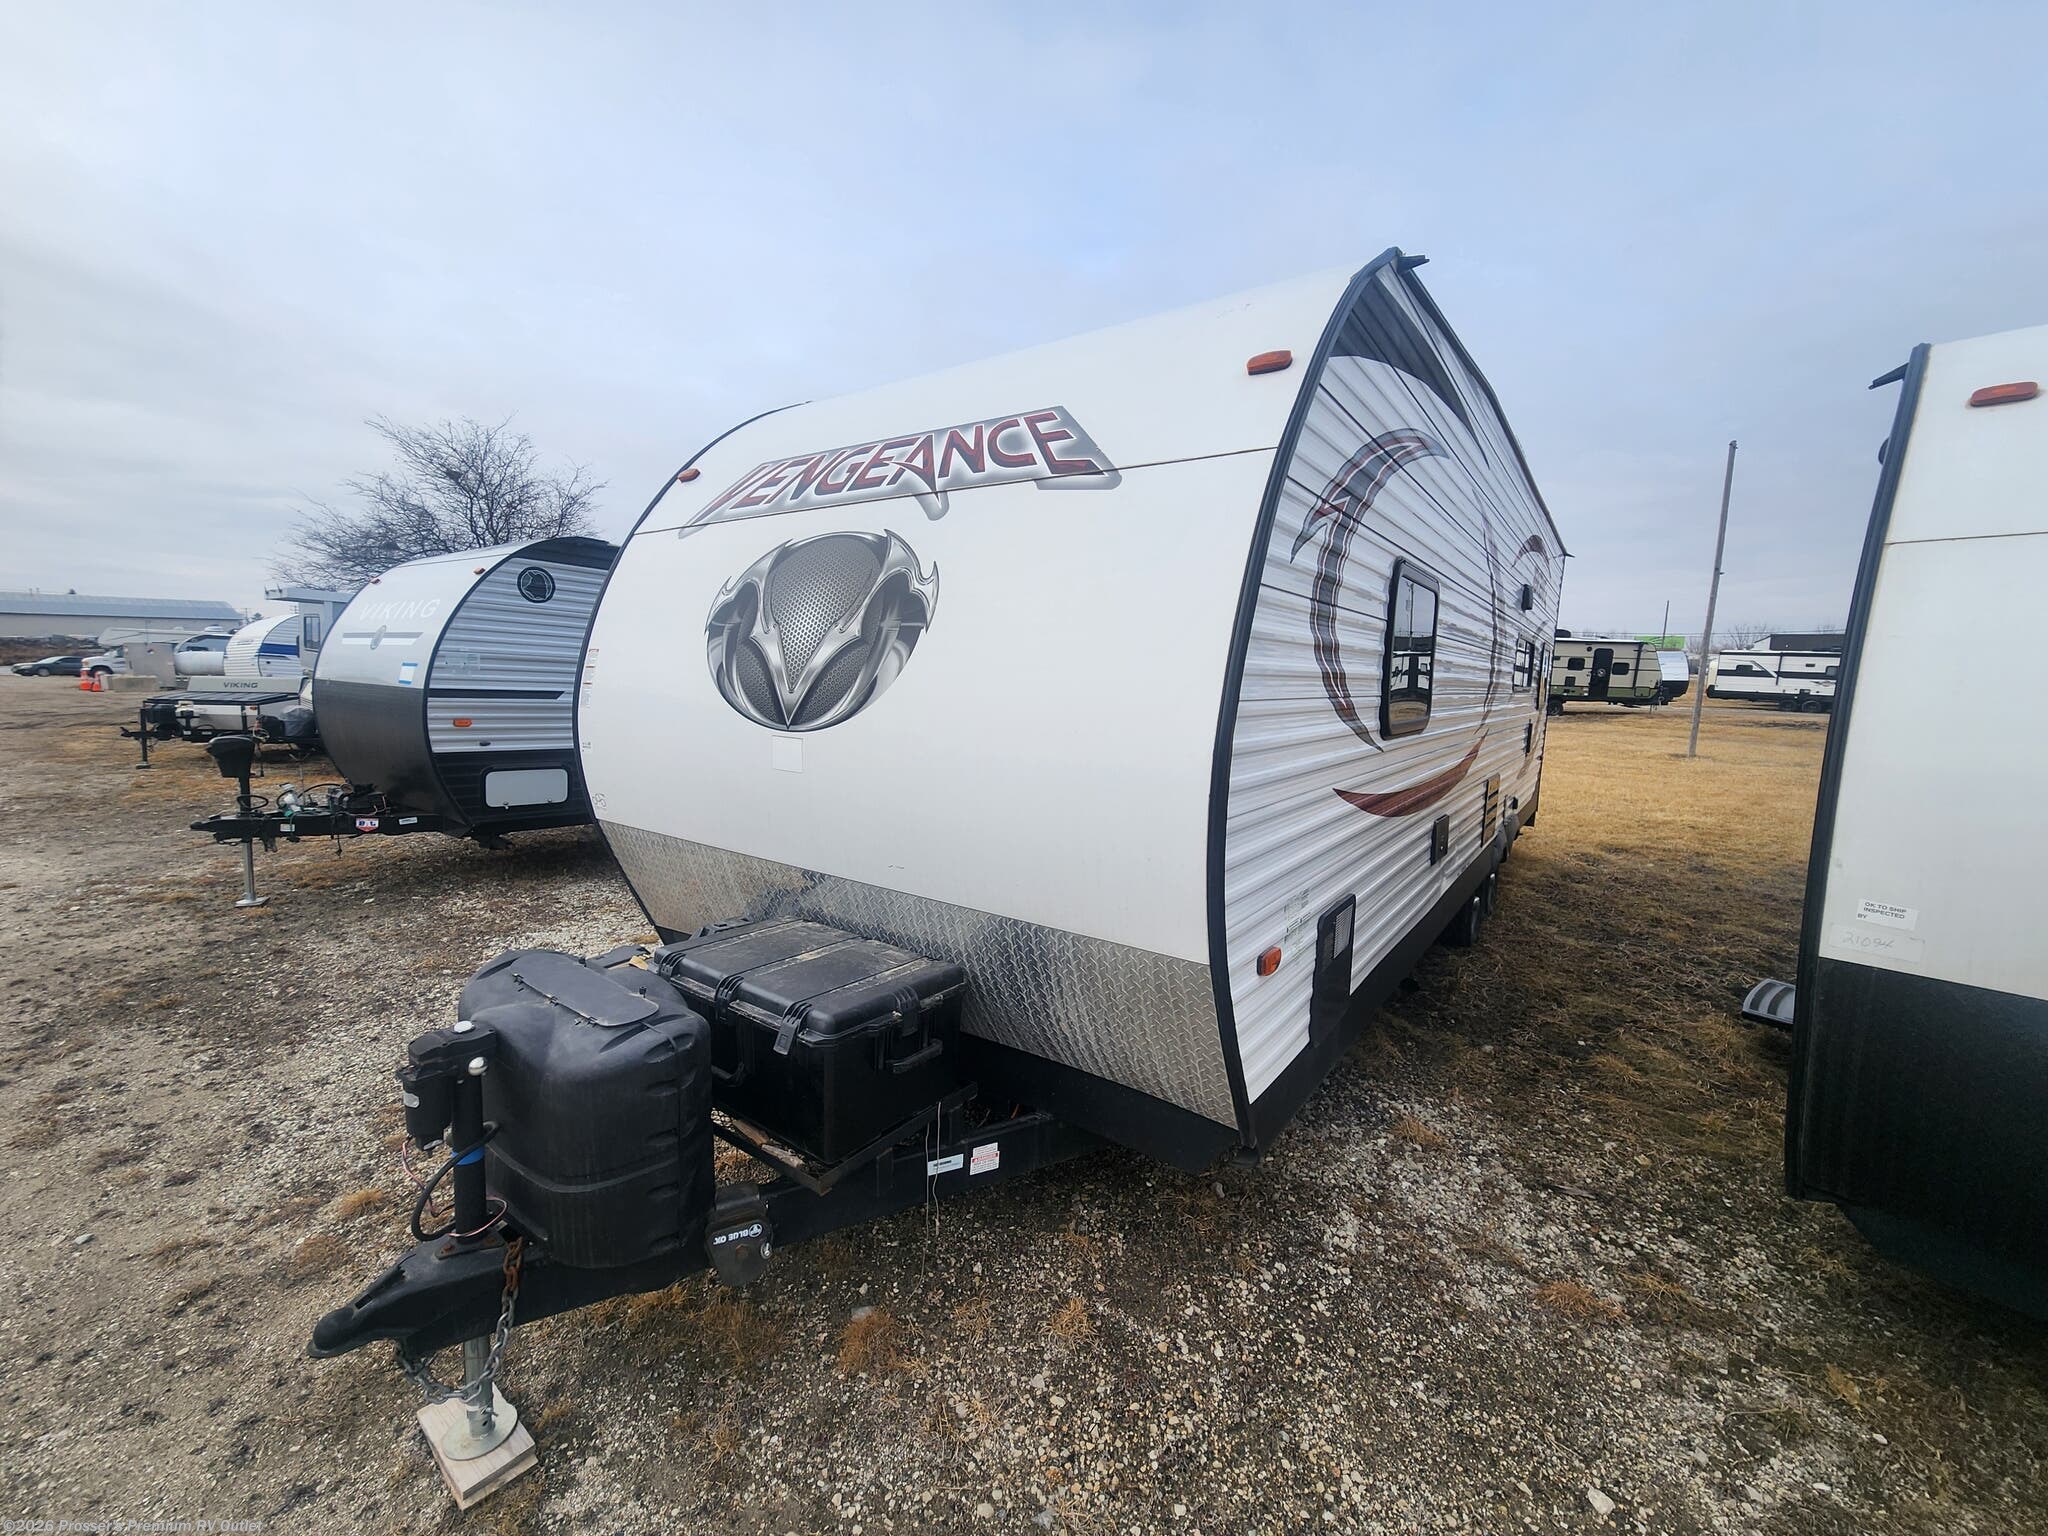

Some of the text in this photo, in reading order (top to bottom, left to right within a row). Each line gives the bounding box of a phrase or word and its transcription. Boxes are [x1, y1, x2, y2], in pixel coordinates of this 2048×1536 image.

[686, 410, 1105, 526] VENGEANCE
[360, 599, 441, 620] VIKING
[1863, 907, 1905, 919] INSPECTED
[713, 1229, 749, 1245] BLUE OX
